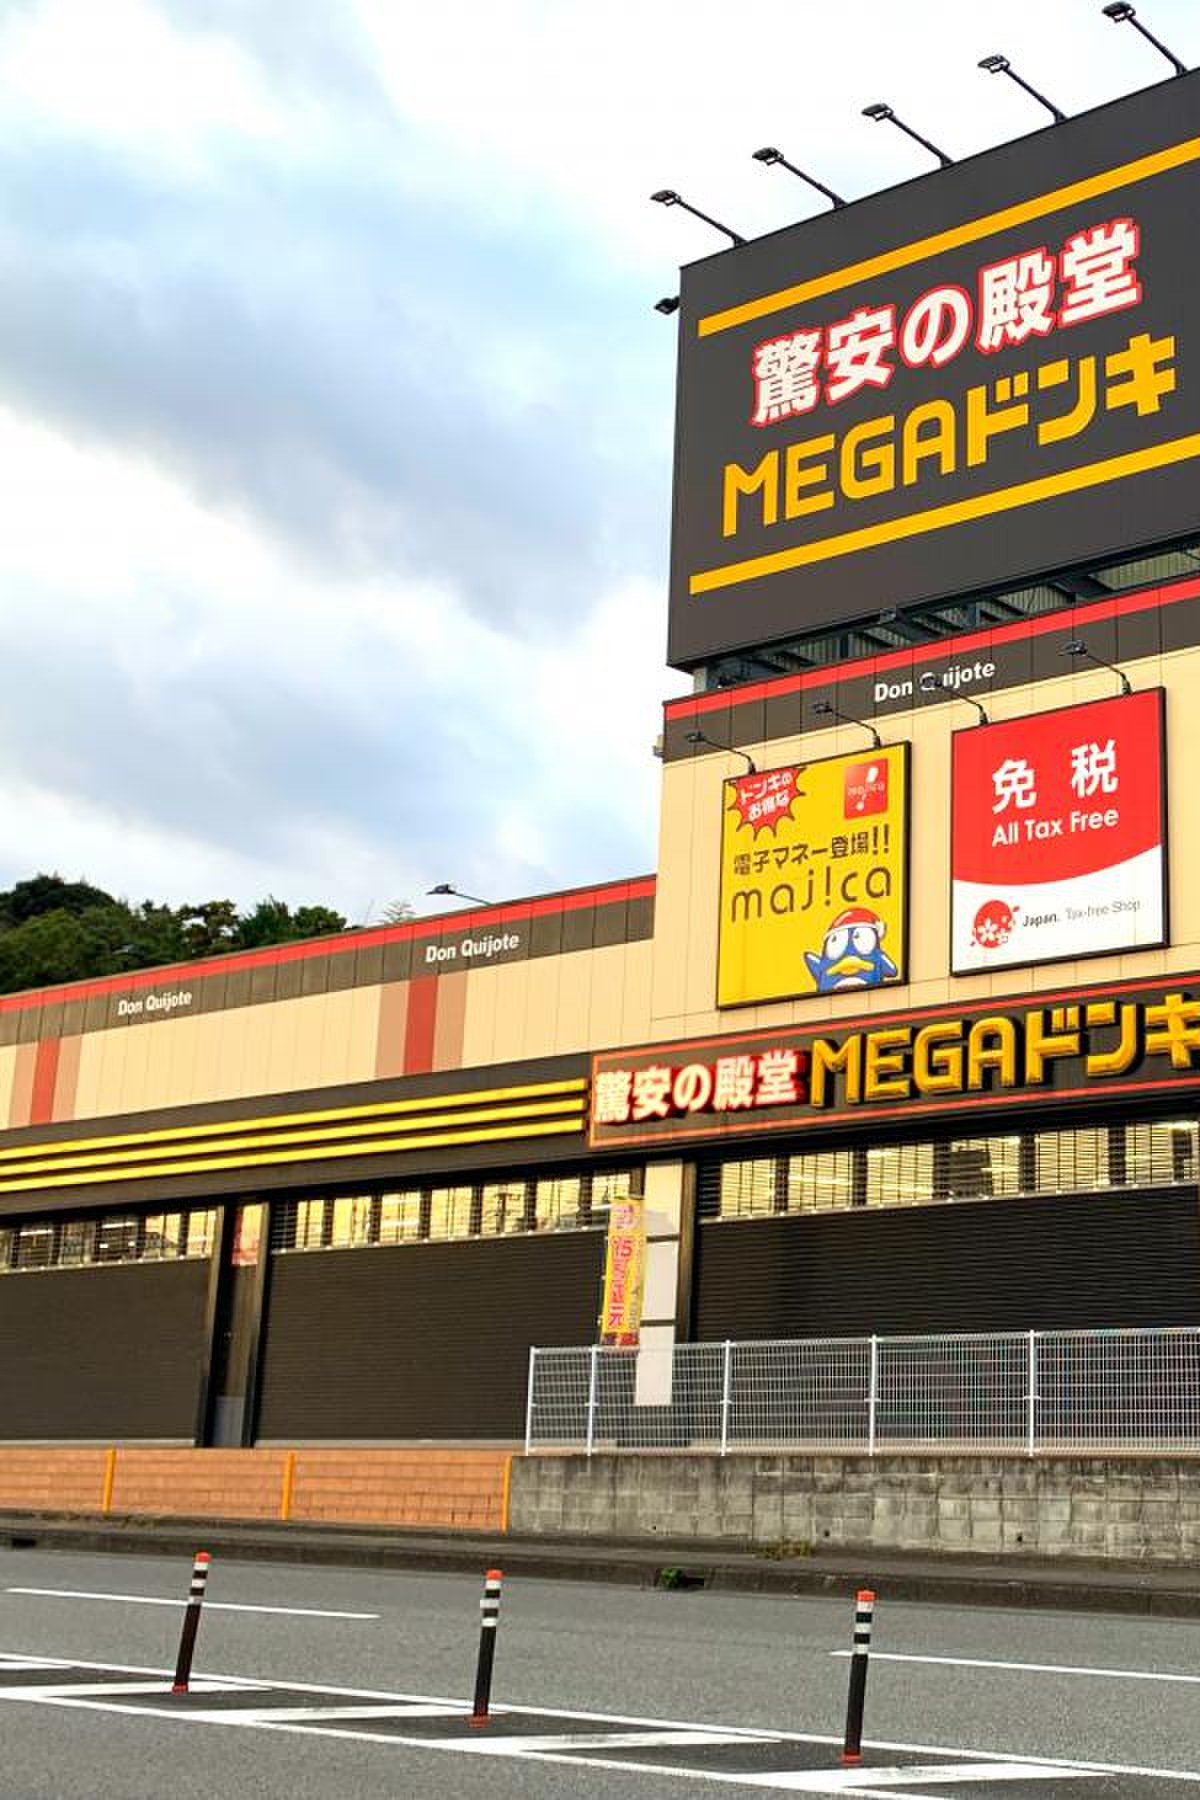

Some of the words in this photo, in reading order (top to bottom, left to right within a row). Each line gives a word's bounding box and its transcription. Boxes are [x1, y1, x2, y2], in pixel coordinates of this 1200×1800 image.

[751, 218, 1141, 427] 驚安の殿堂
[722, 333, 1177, 538] MEGAドンキ
[874, 681, 913, 702] Don
[991, 822, 1019, 847] All
[1024, 818, 1063, 841] Tax
[1070, 808, 1119, 832] Free
[426, 945, 457, 962] Don
[461, 934, 520, 957] Quijote
[118, 1000, 143, 1016] Don
[146, 992, 193, 1012] Quijote
[593, 1049, 801, 1123] 驚安の殿堂
